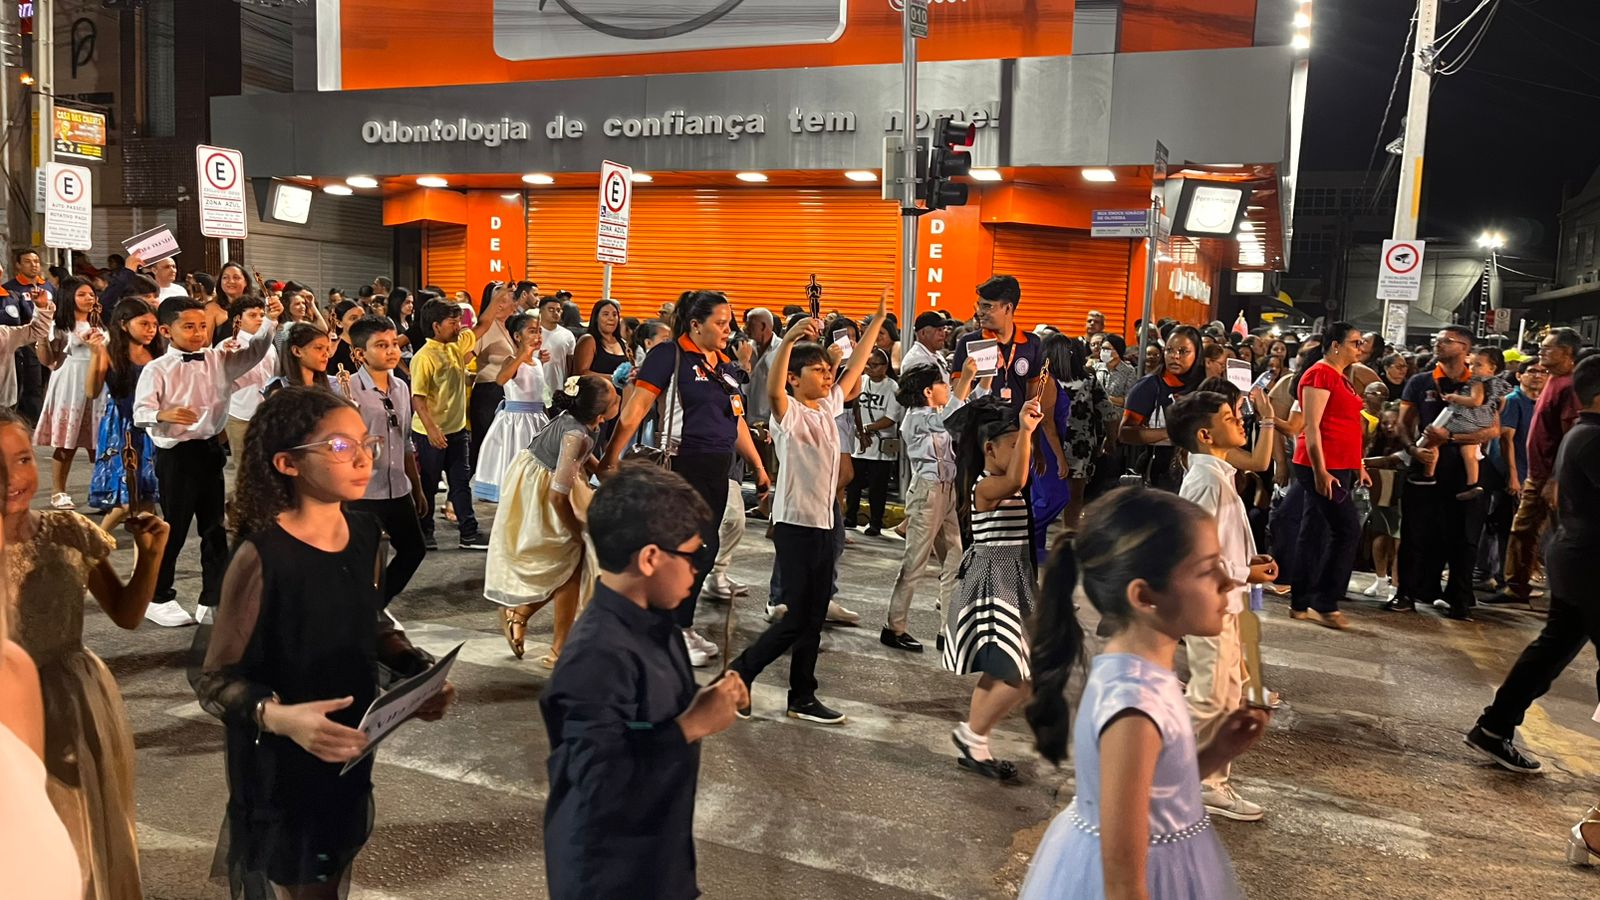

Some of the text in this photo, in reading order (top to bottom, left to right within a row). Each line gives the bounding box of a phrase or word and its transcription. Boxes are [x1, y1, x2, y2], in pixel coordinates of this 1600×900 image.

[911, 7, 927, 24] 010
[361, 117, 528, 147] Odontologia
[545, 115, 584, 140] de
[602, 109, 766, 141] confiança
[788, 107, 857, 133] tem
[215, 162, 226, 181] E
[64, 177, 73, 195] E
[612, 180, 620, 202] E
[926, 218, 945, 307] DENT
[858, 392, 885, 406] CRI
